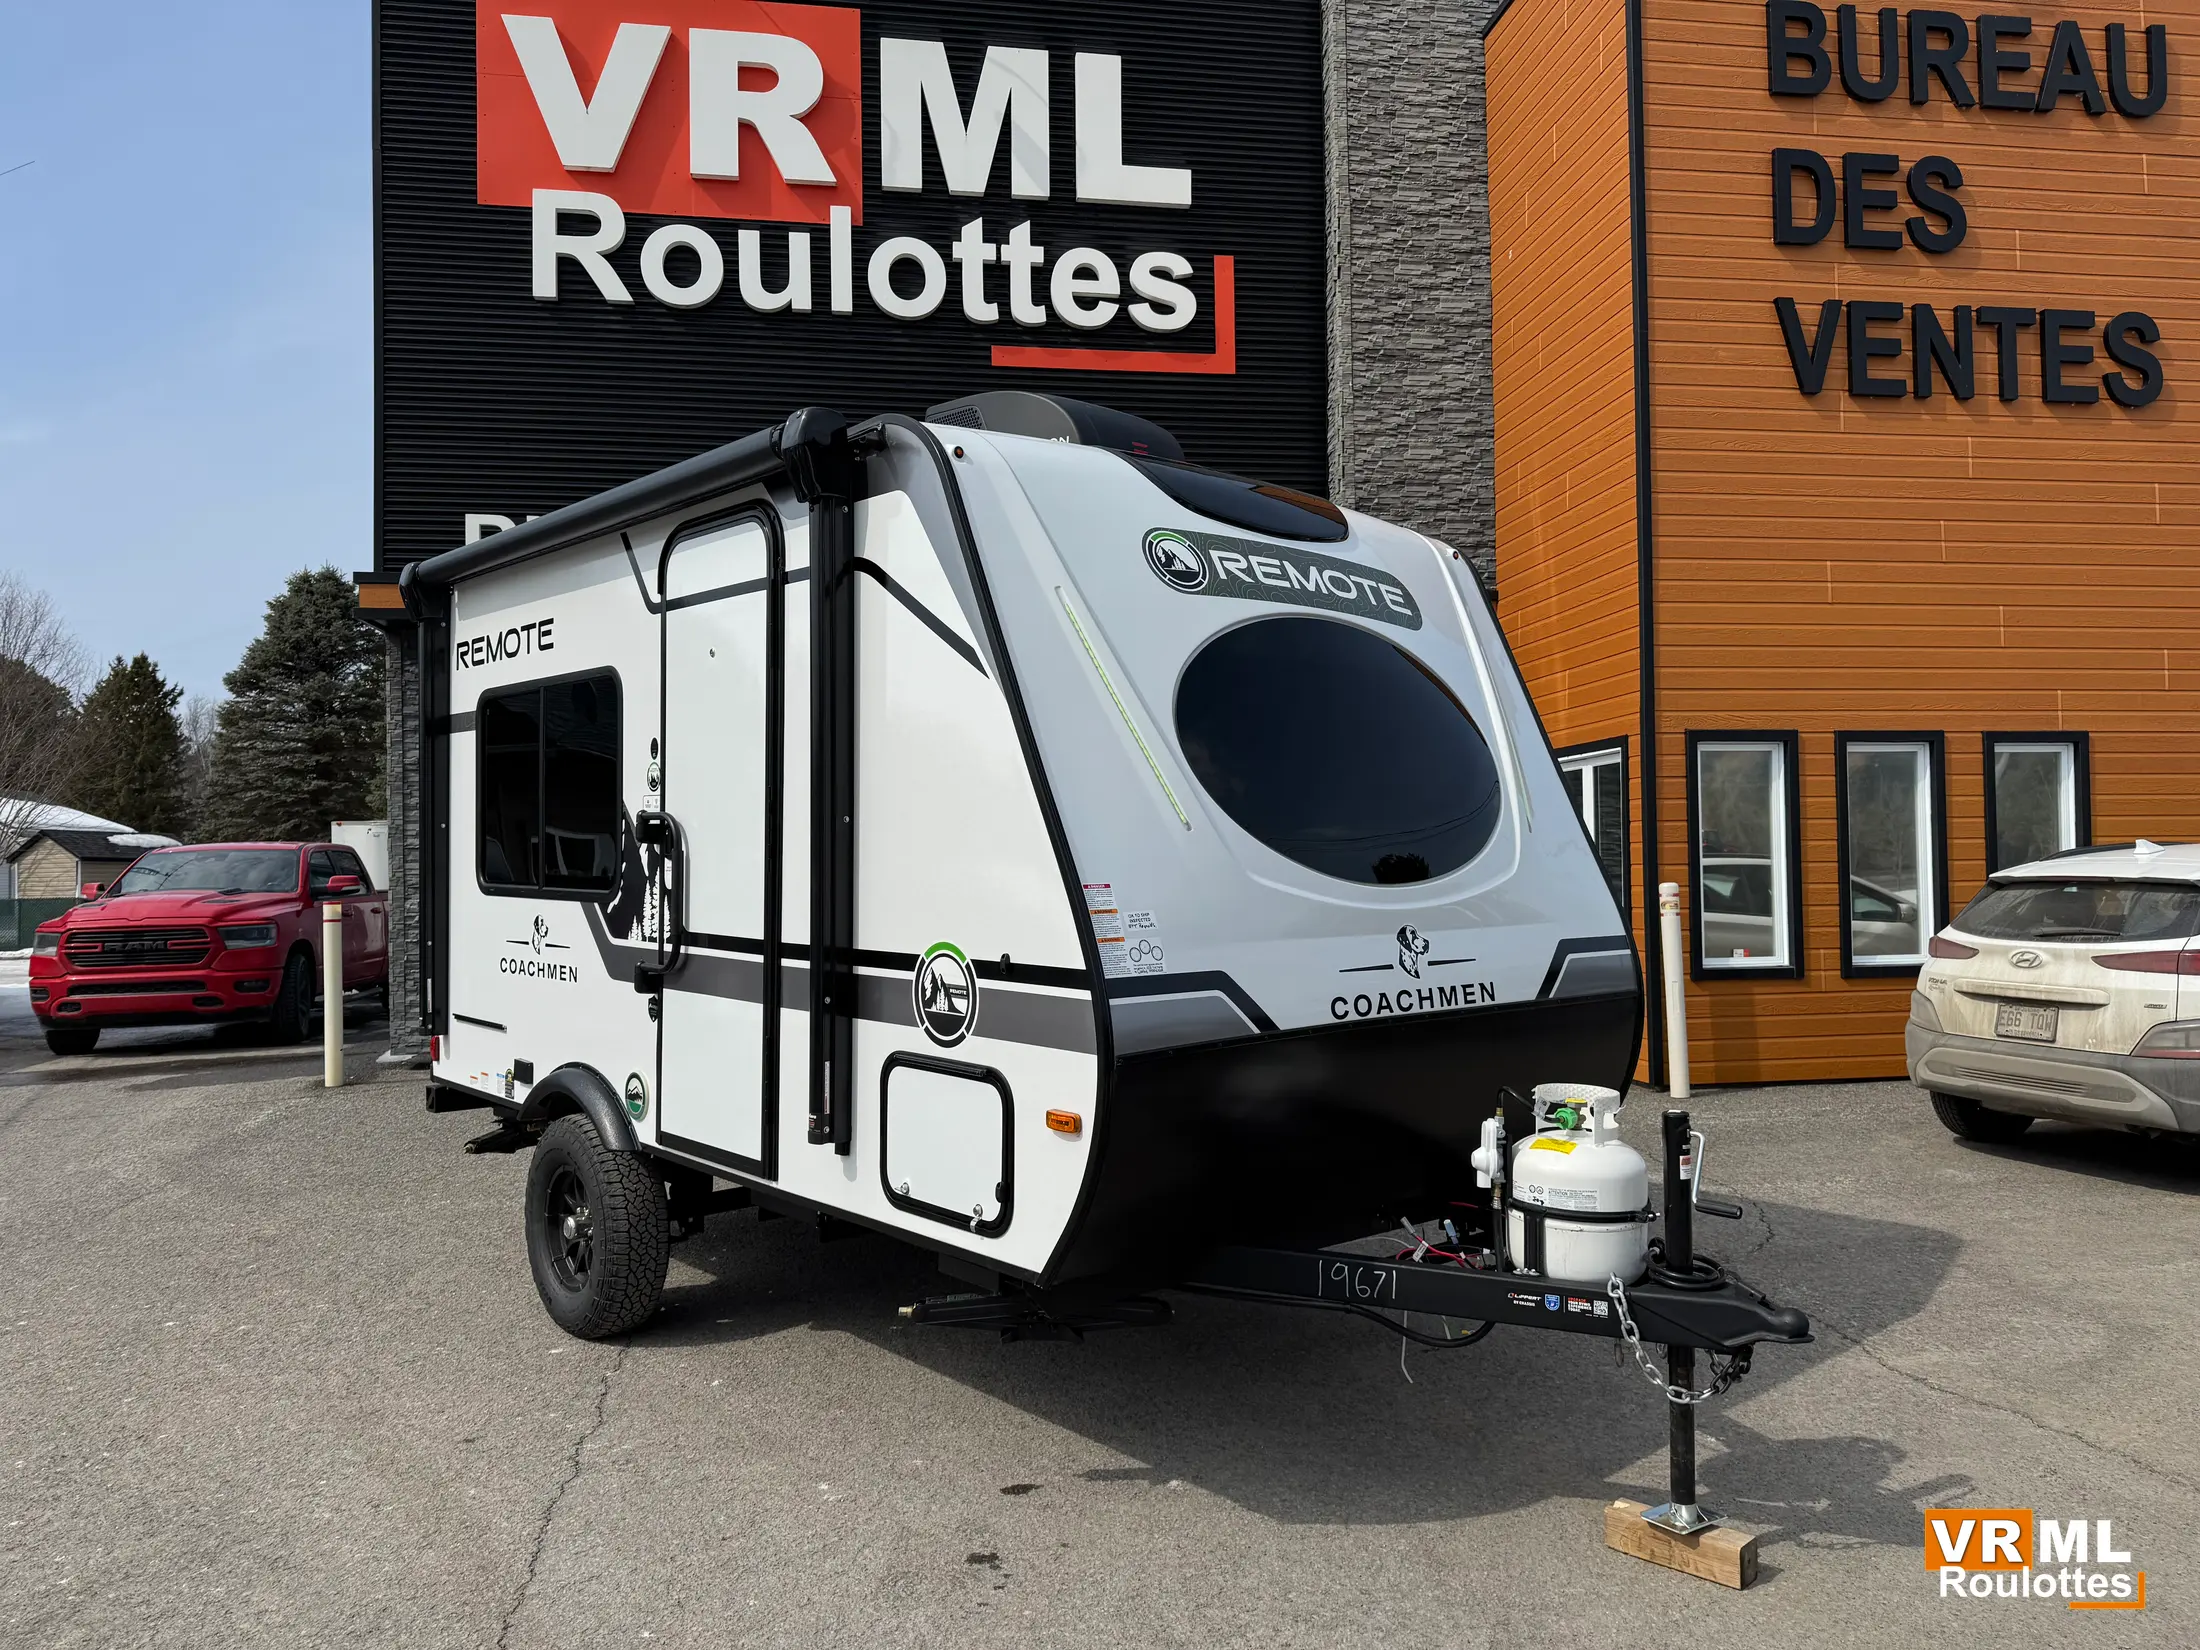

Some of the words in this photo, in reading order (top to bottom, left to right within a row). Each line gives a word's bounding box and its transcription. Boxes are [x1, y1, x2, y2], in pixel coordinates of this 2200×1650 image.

[1766, 0, 2168, 118] BUREAU
[1772, 148, 1968, 255] DES
[532, 188, 1197, 334] Roulottes
[1774, 297, 2164, 409] VENTES
[1208, 549, 1413, 616] REMOTE
[456, 618, 555, 671] REMOTE
[104, 940, 165, 951] RAM
[500, 957, 578, 983] COACHMEN
[1330, 981, 1496, 1020] COACHMEN
[1998, 1010, 2022, 1027] E66
[1318, 1260, 1396, 1299] 19671
